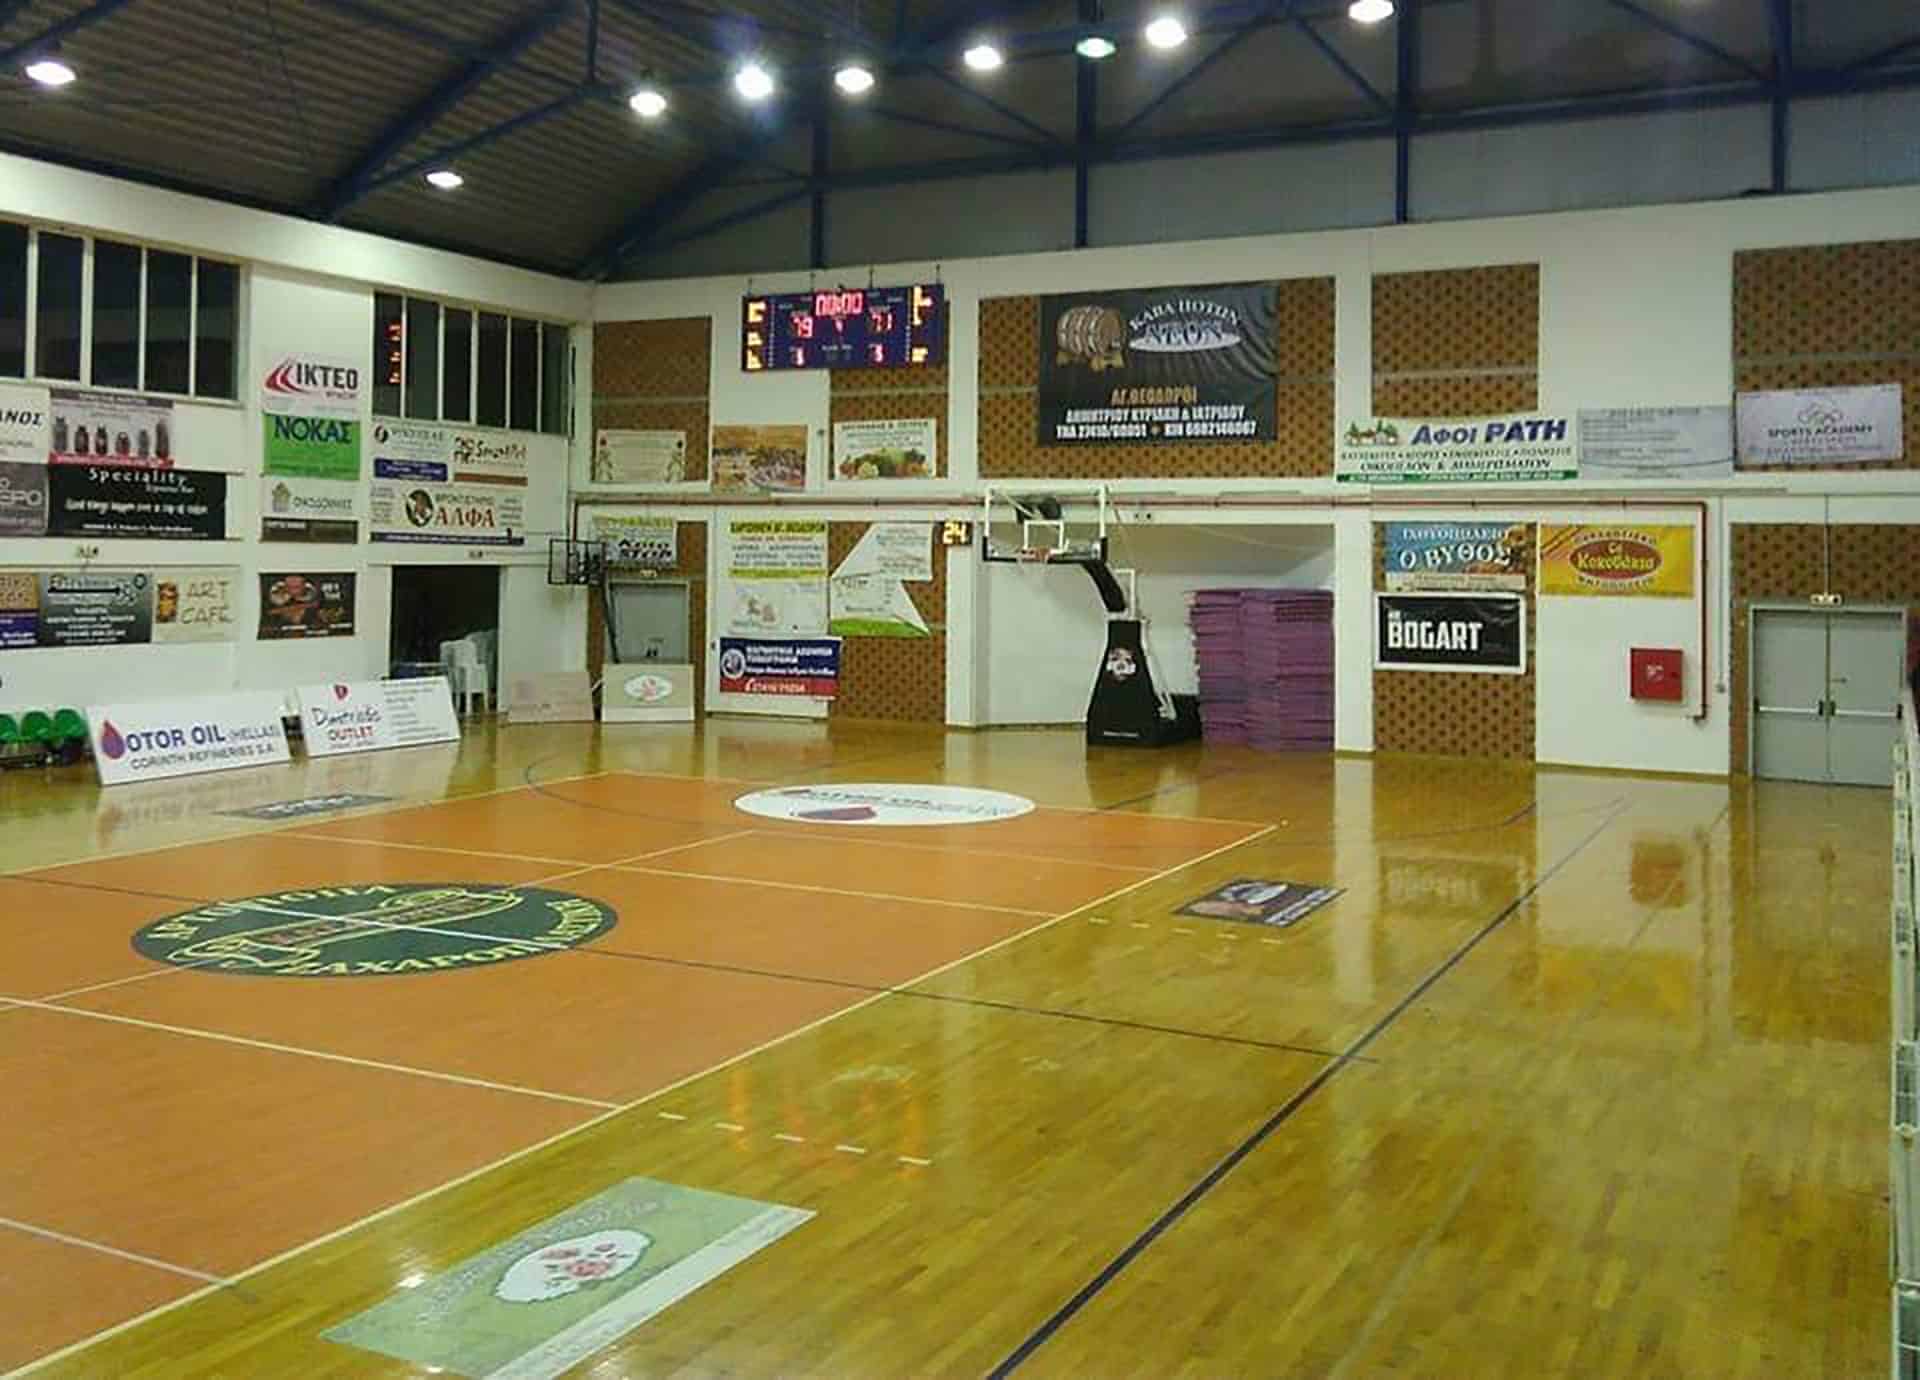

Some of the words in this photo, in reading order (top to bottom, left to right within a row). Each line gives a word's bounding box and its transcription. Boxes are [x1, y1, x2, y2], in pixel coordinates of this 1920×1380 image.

[296, 362, 359, 390] ΙΚΤΕΟ
[0, 409, 43, 427] ΝΟΣ
[275, 416, 353, 444] ΝΟΚΑΣ
[1485, 419, 1567, 442] ΡΑΤΗ
[1768, 427, 1812, 438] SPORTS
[1815, 424, 1873, 435] ACADEMY
[89, 467, 187, 487] Speciality
[942, 522, 968, 545] 24
[1424, 541, 1511, 568] ΒΥΘΟΣ
[186, 581, 229, 598] ART
[1388, 621, 1483, 650] BOGART
[191, 725, 226, 745] OIL
